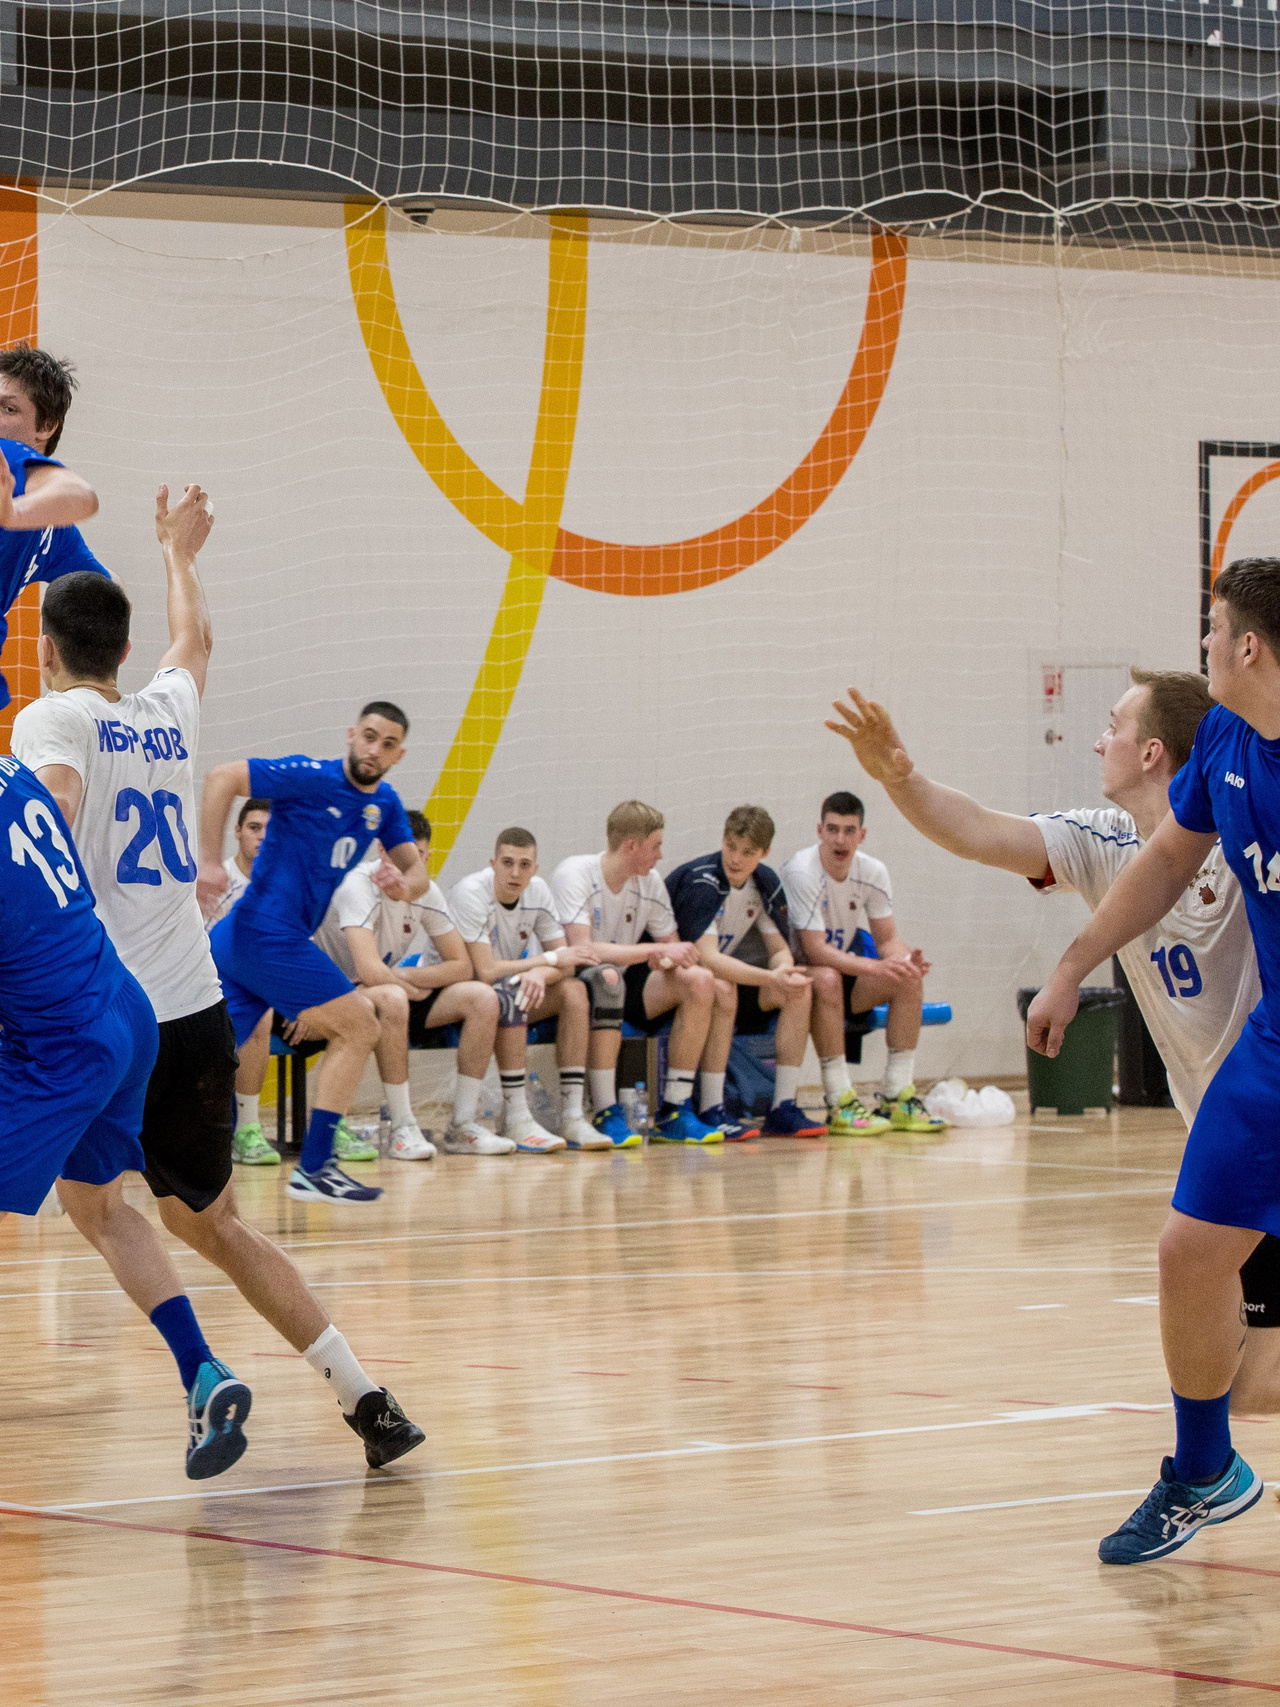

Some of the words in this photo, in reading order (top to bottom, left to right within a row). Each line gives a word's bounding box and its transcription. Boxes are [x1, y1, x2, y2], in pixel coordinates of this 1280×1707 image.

[8, 799, 80, 909] 13
[115, 787, 198, 886] 20
[1150, 944, 1203, 998] 19
